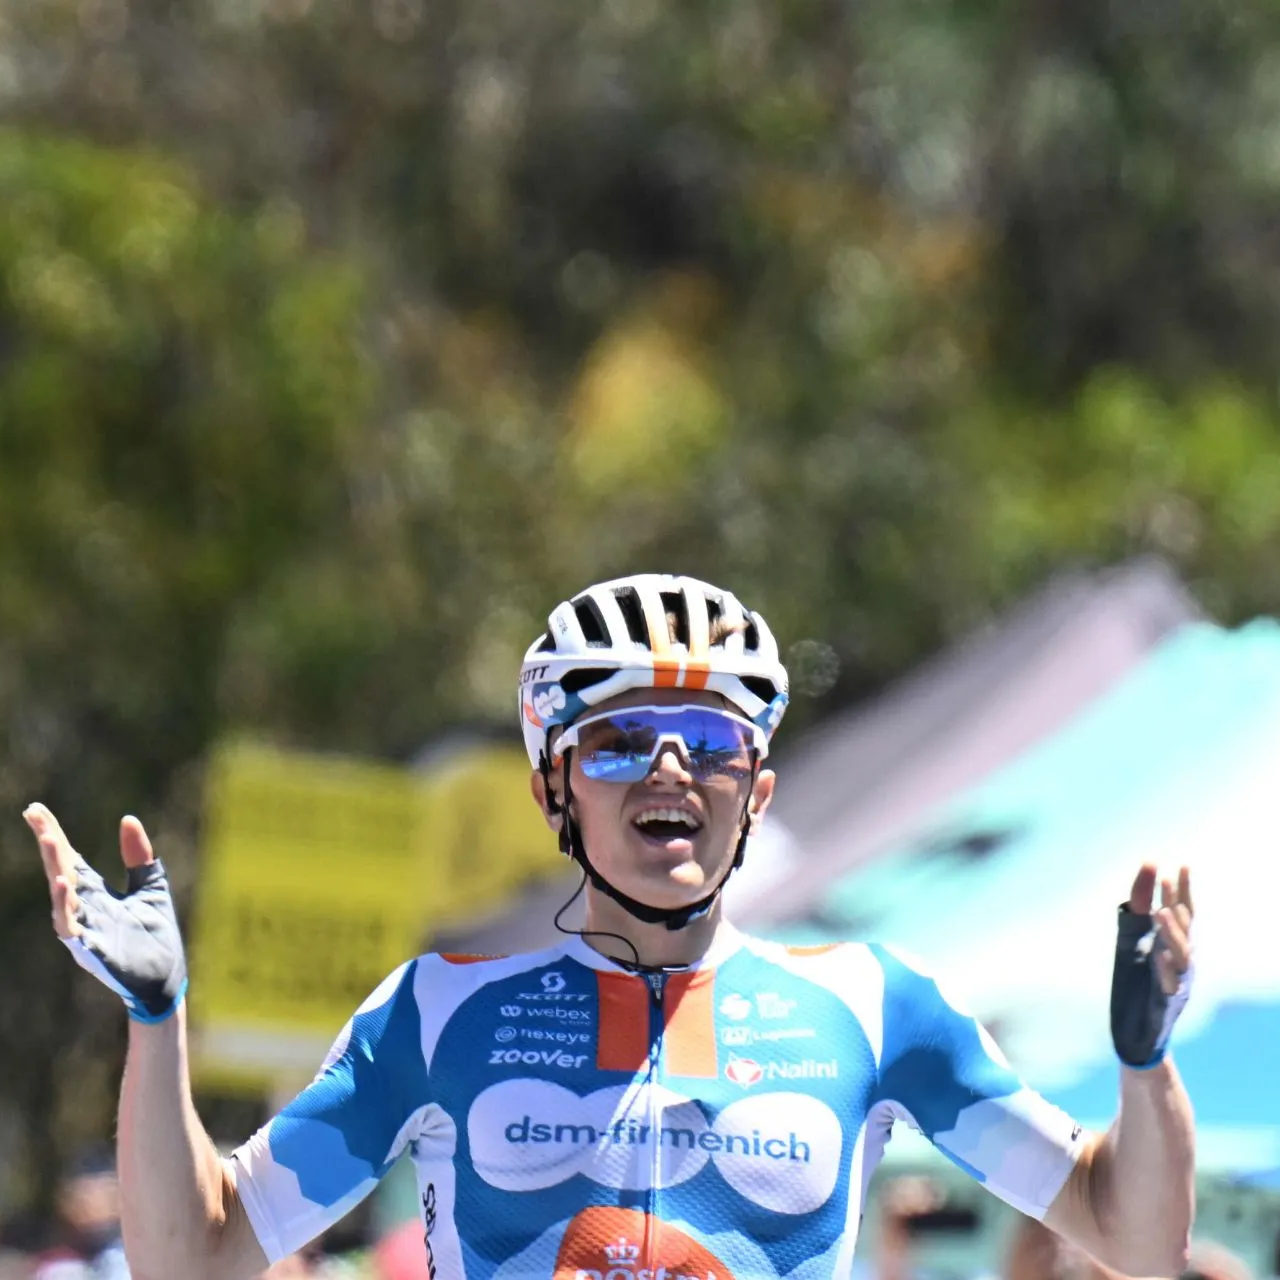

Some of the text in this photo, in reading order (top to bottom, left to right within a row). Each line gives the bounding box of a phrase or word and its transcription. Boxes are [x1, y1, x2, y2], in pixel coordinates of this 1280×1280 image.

[519, 664, 550, 685] OTT
[527, 1005, 591, 1020] webex
[766, 1058, 839, 1080] Nalini
[504, 1115, 811, 1163] dsm-firmenich
